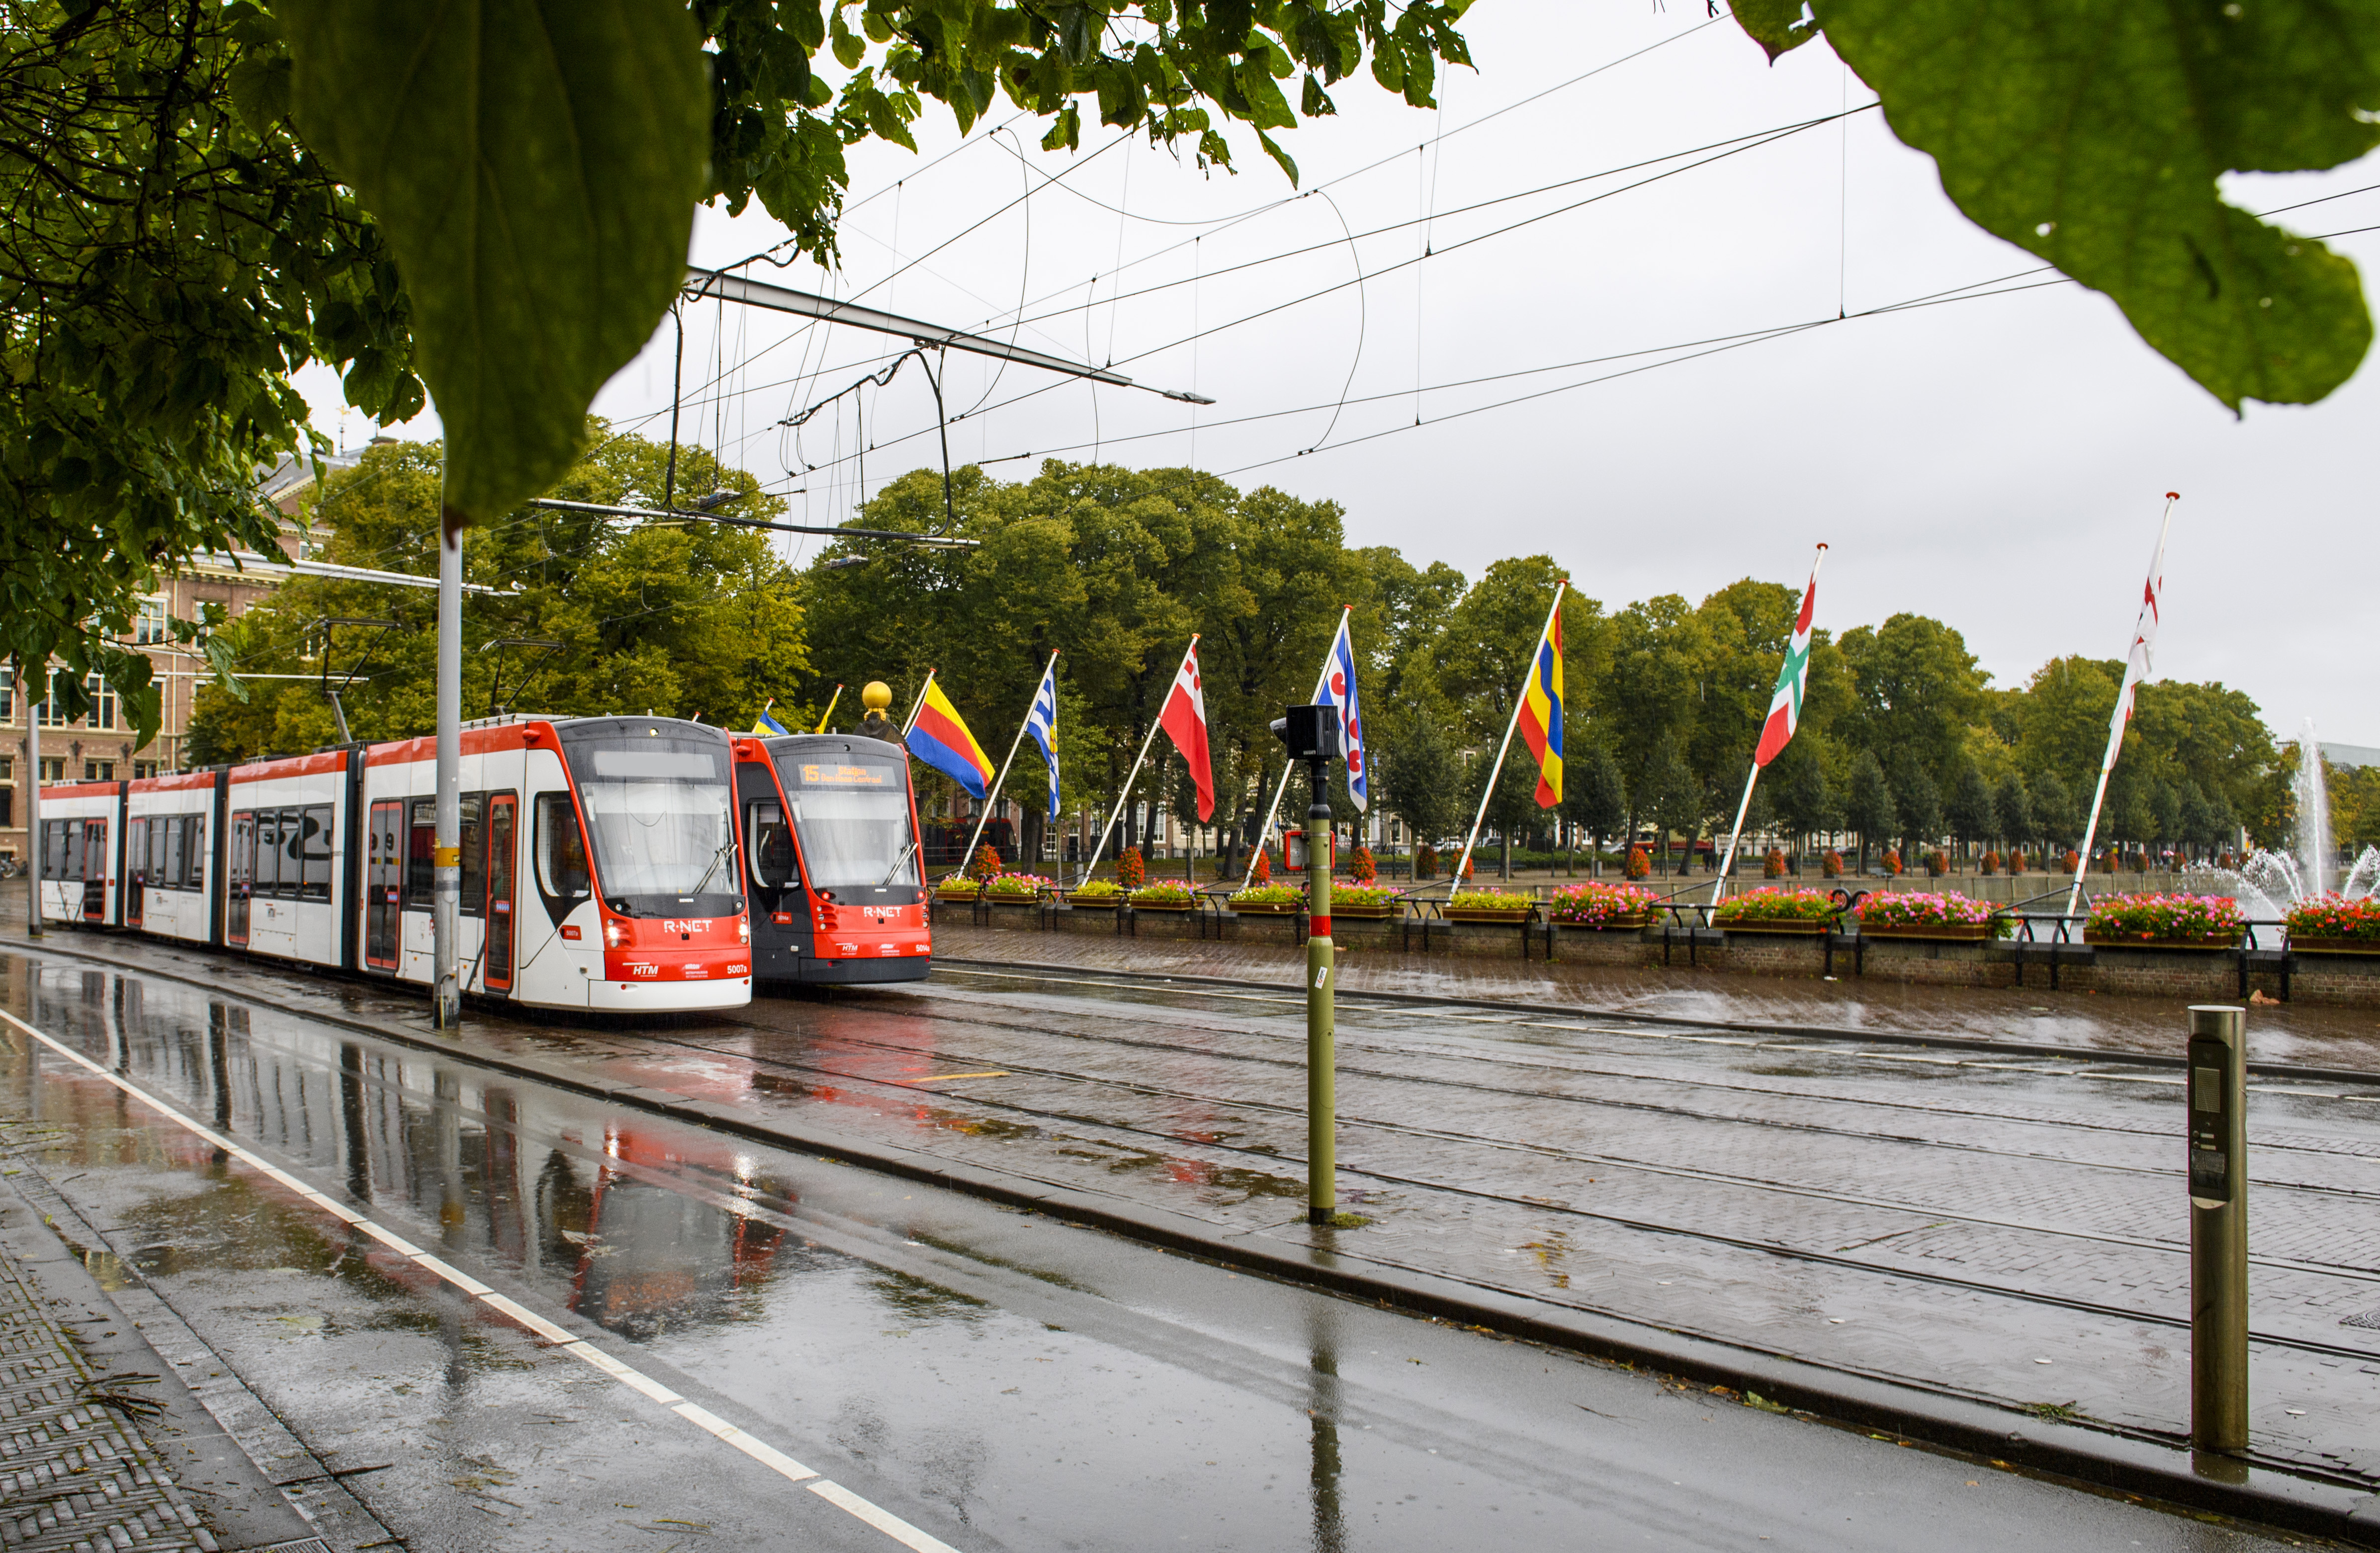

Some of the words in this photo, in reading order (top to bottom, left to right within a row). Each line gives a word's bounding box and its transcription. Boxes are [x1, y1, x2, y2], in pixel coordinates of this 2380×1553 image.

[802, 765, 819, 782] 15
[821, 773, 834, 782] Den
[853, 775, 882, 783] Centraal
[633, 965, 659, 975] HTM
[727, 964, 747, 974] 5007a
